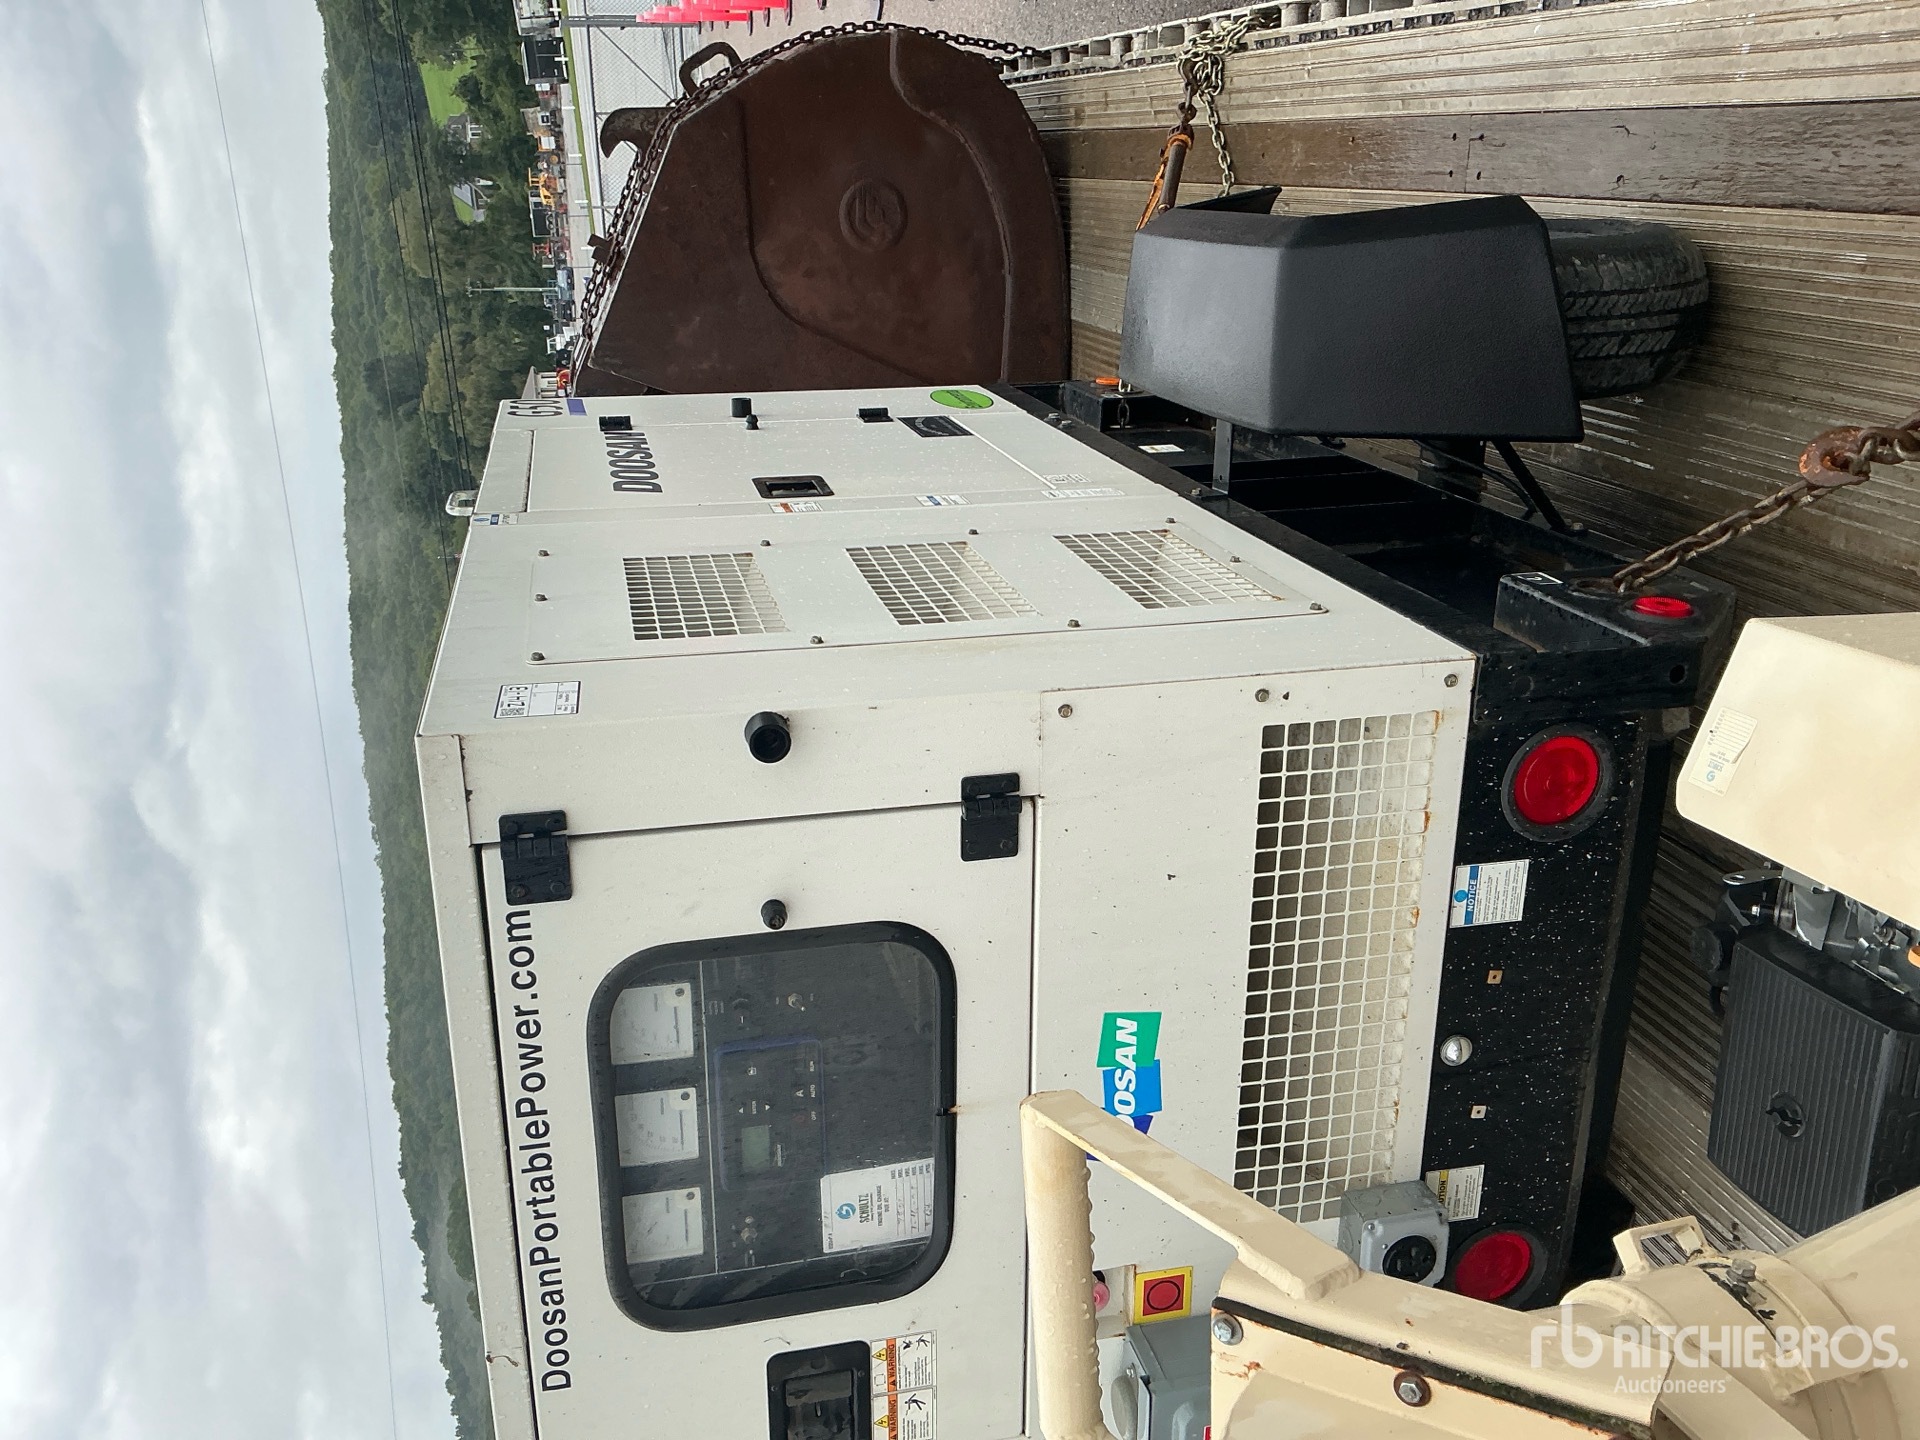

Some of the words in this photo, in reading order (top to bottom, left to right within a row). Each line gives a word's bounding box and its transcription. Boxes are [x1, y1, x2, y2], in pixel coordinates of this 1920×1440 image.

[604, 431, 663, 493] DOOSAN
[1467, 879, 1477, 912] NOTICE
[504, 909, 571, 1391] DoosanPortablePower.com
[858, 1193, 869, 1223] SCHULTZ
[1439, 1180, 1447, 1204] UTION
